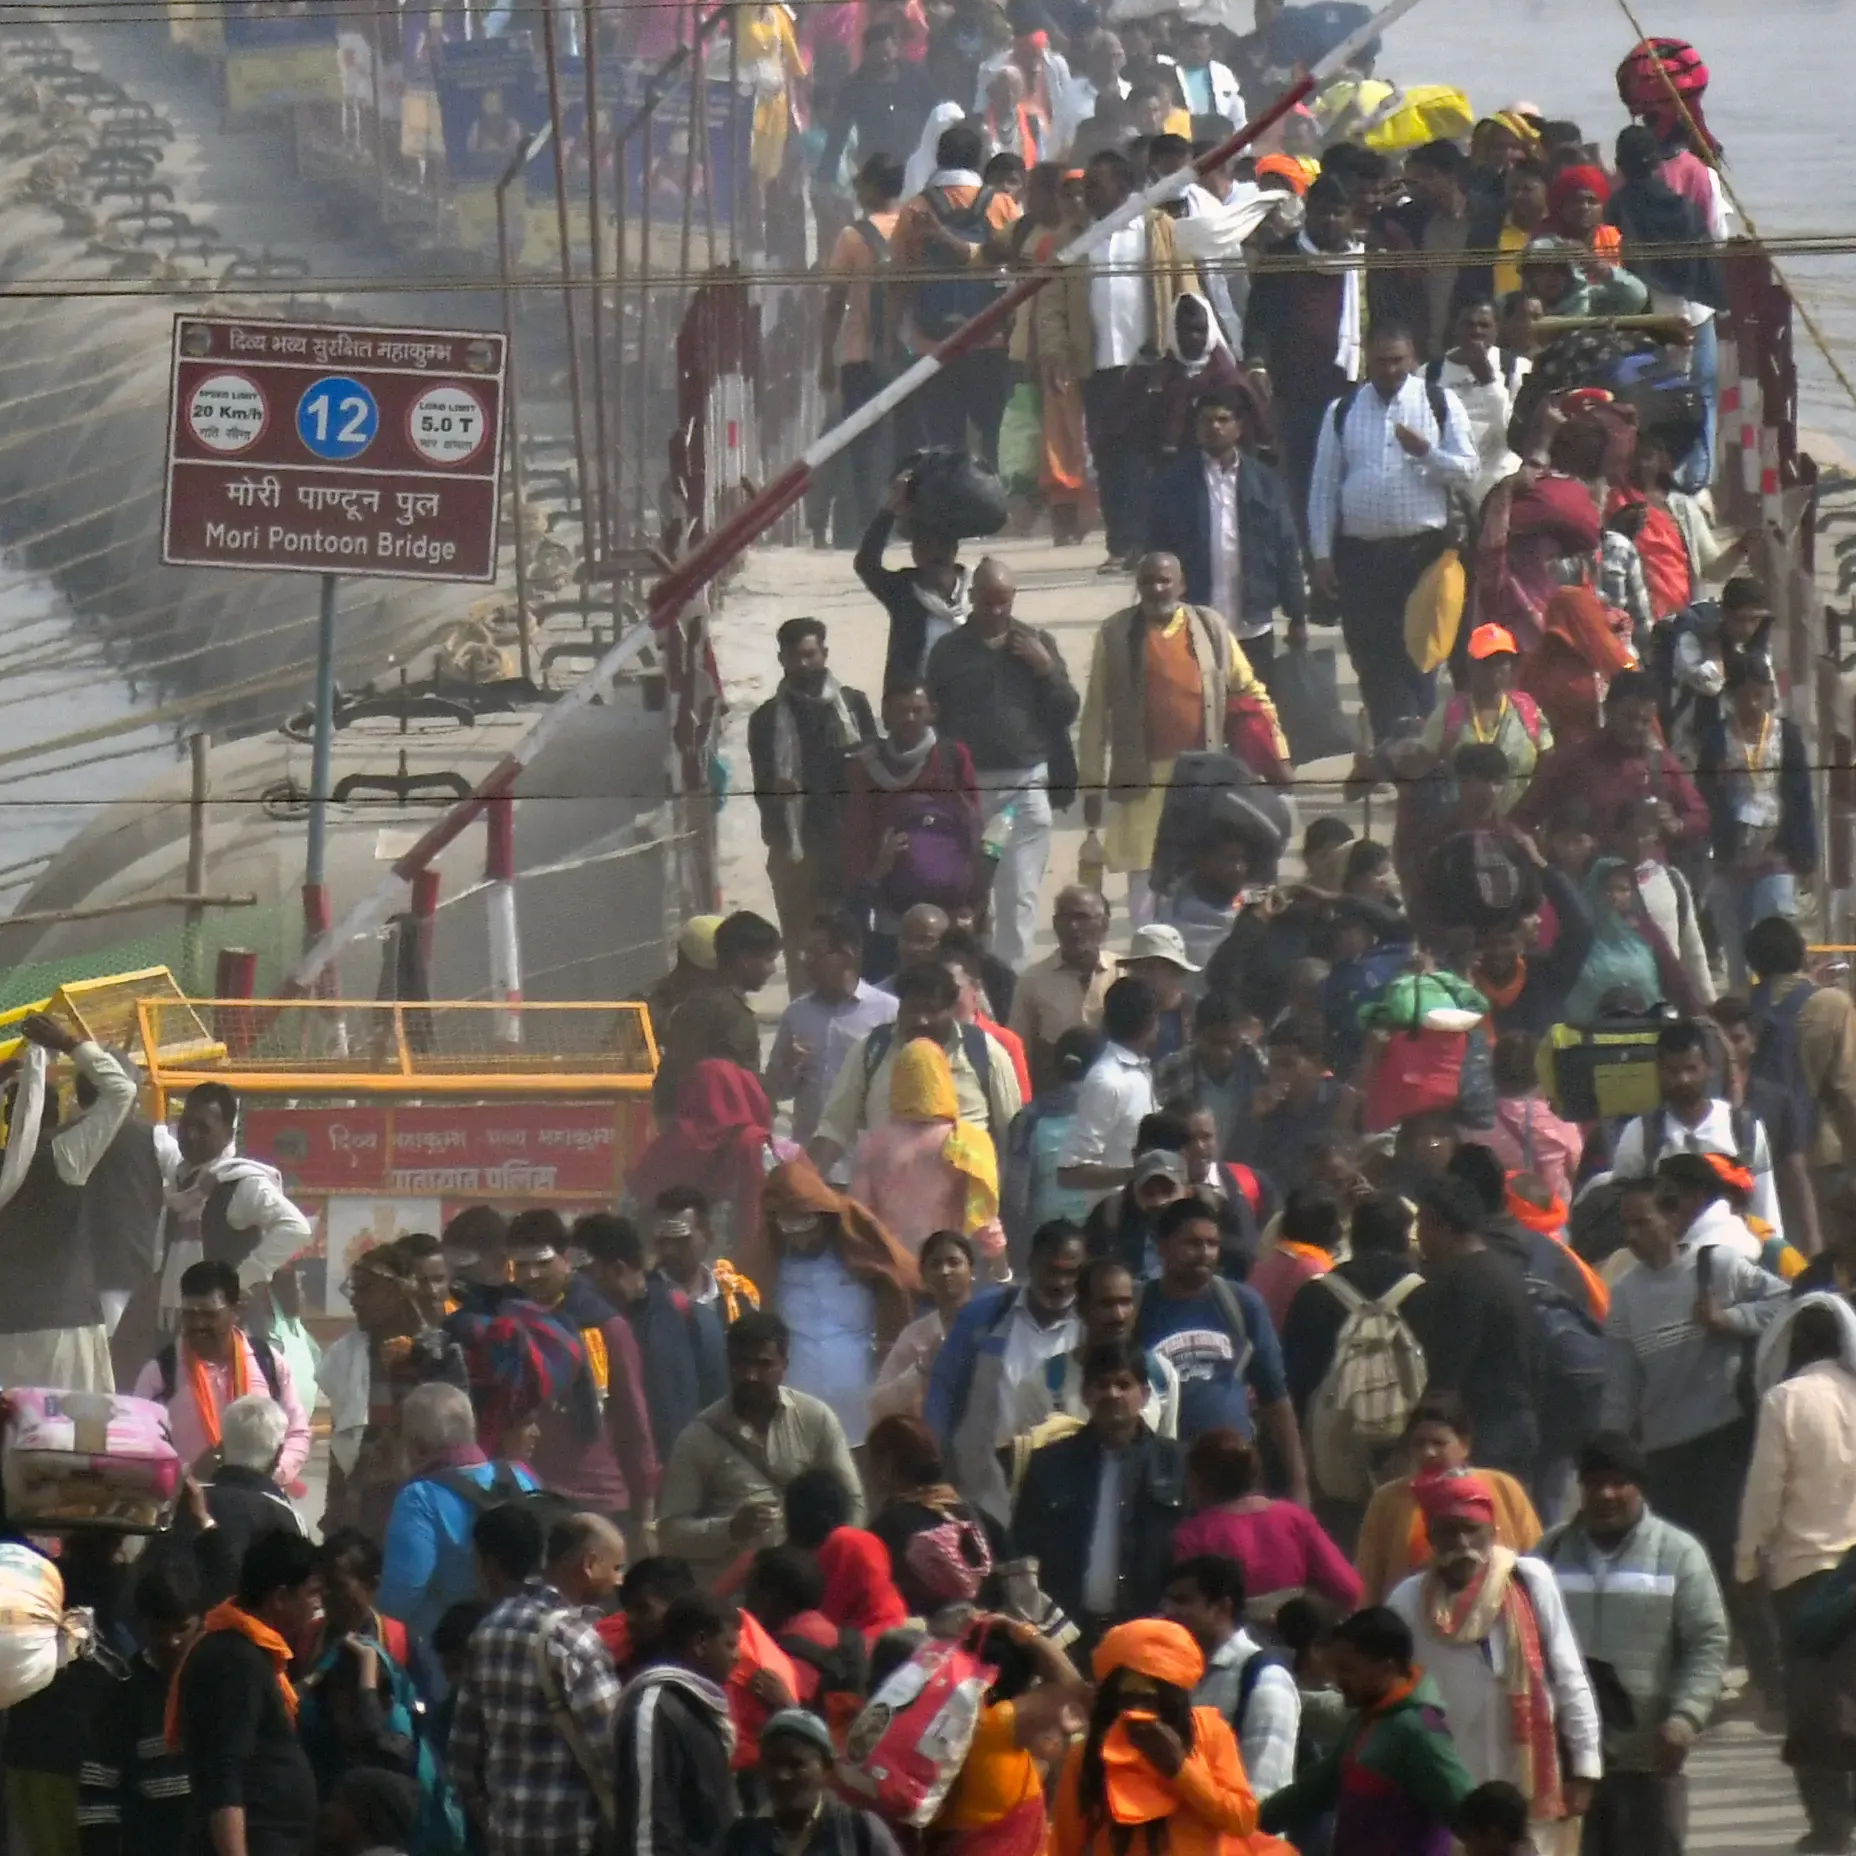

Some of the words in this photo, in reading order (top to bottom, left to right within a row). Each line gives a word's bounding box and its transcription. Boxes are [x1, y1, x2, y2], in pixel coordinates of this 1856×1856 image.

[193, 404, 213, 418] 20
[220, 405, 263, 421] Km/h
[306, 394, 370, 443] 12
[421, 416, 453, 433] 5.0
[459, 417, 474, 433] T
[225, 476, 281, 508] मोरी
[298, 486, 380, 521] पाण्टून
[396, 491, 440, 526] पुल
[205, 522, 259, 549] Mori
[269, 526, 369, 556] Pontoon
[377, 531, 456, 564] Bridge
